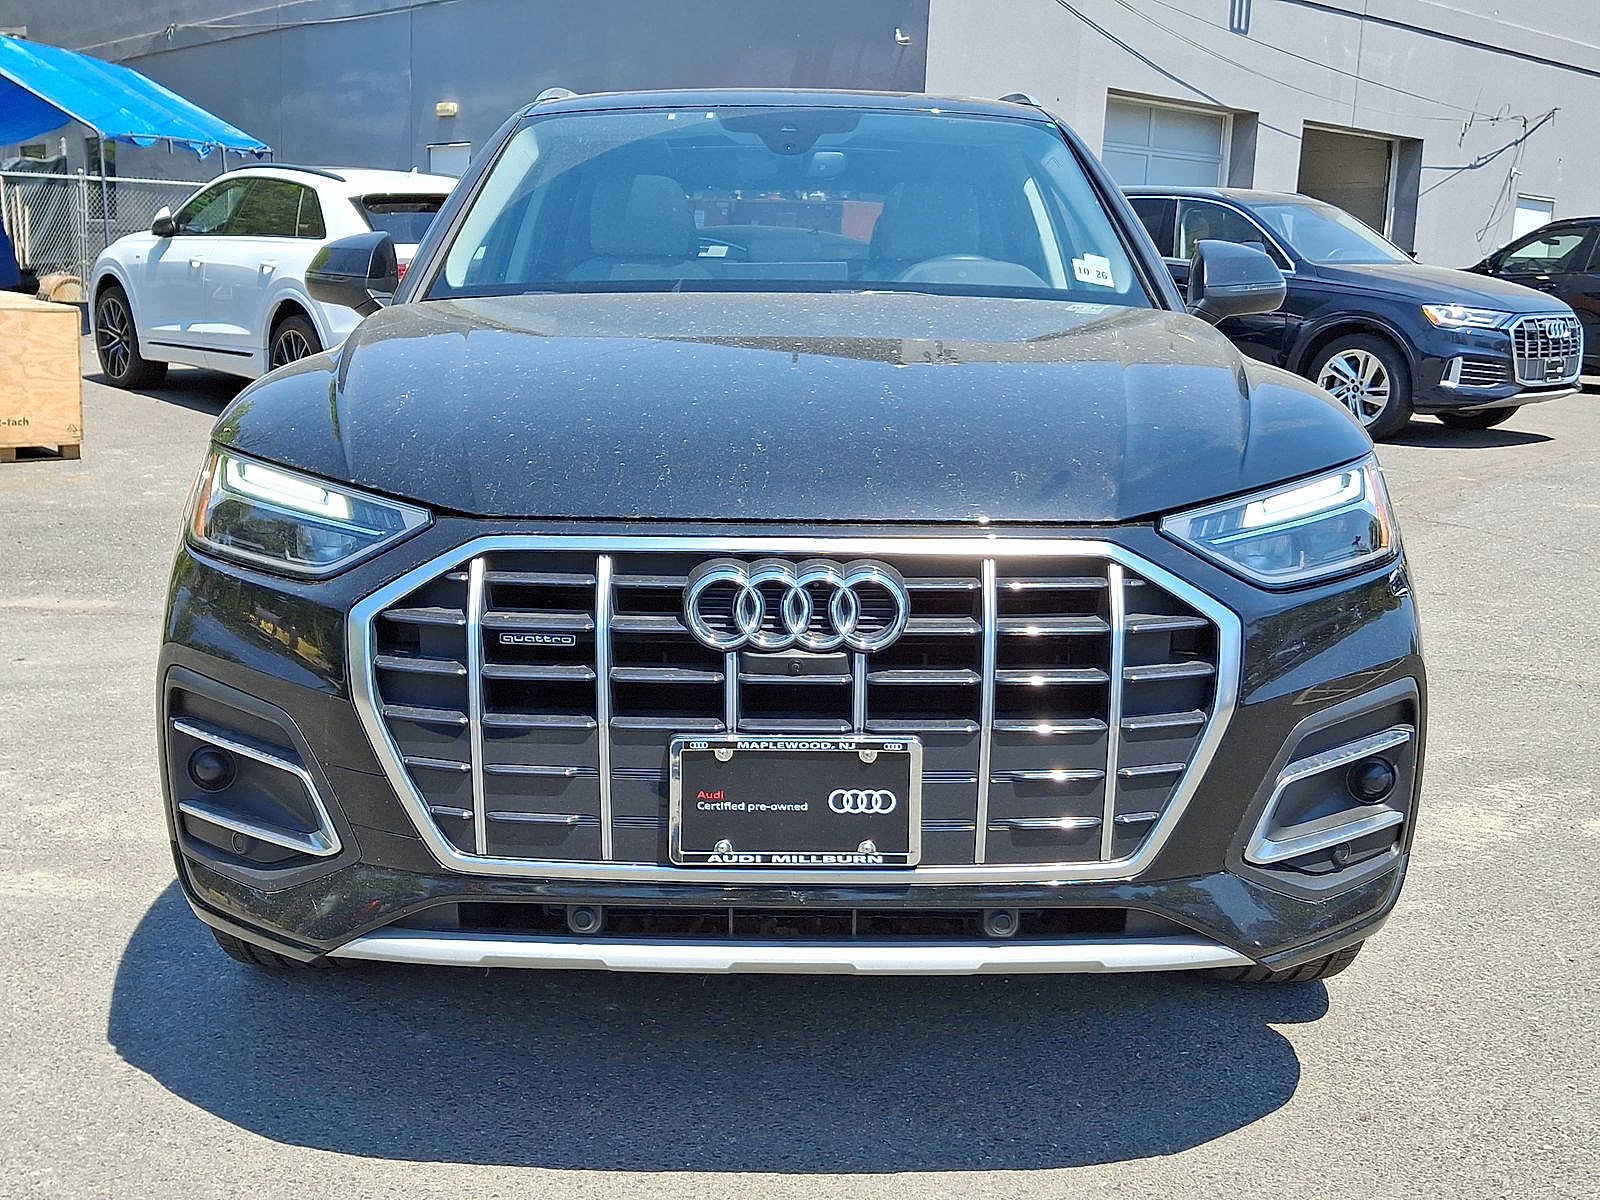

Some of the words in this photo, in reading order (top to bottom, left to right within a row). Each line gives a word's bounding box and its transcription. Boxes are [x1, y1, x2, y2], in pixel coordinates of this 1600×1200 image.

[1078, 266, 1090, 275] 10
[1095, 269, 1108, 279] 26
[502, 635, 572, 643] quattro
[736, 741, 835, 750] MAPLEWOOD,
[838, 742, 856, 750] NJ
[696, 790, 725, 799] Audi
[696, 801, 745, 811] Certified
[747, 802, 808, 812] pre-owned
[707, 855, 762, 863] AUDI
[771, 855, 883, 863] MILLBURN
